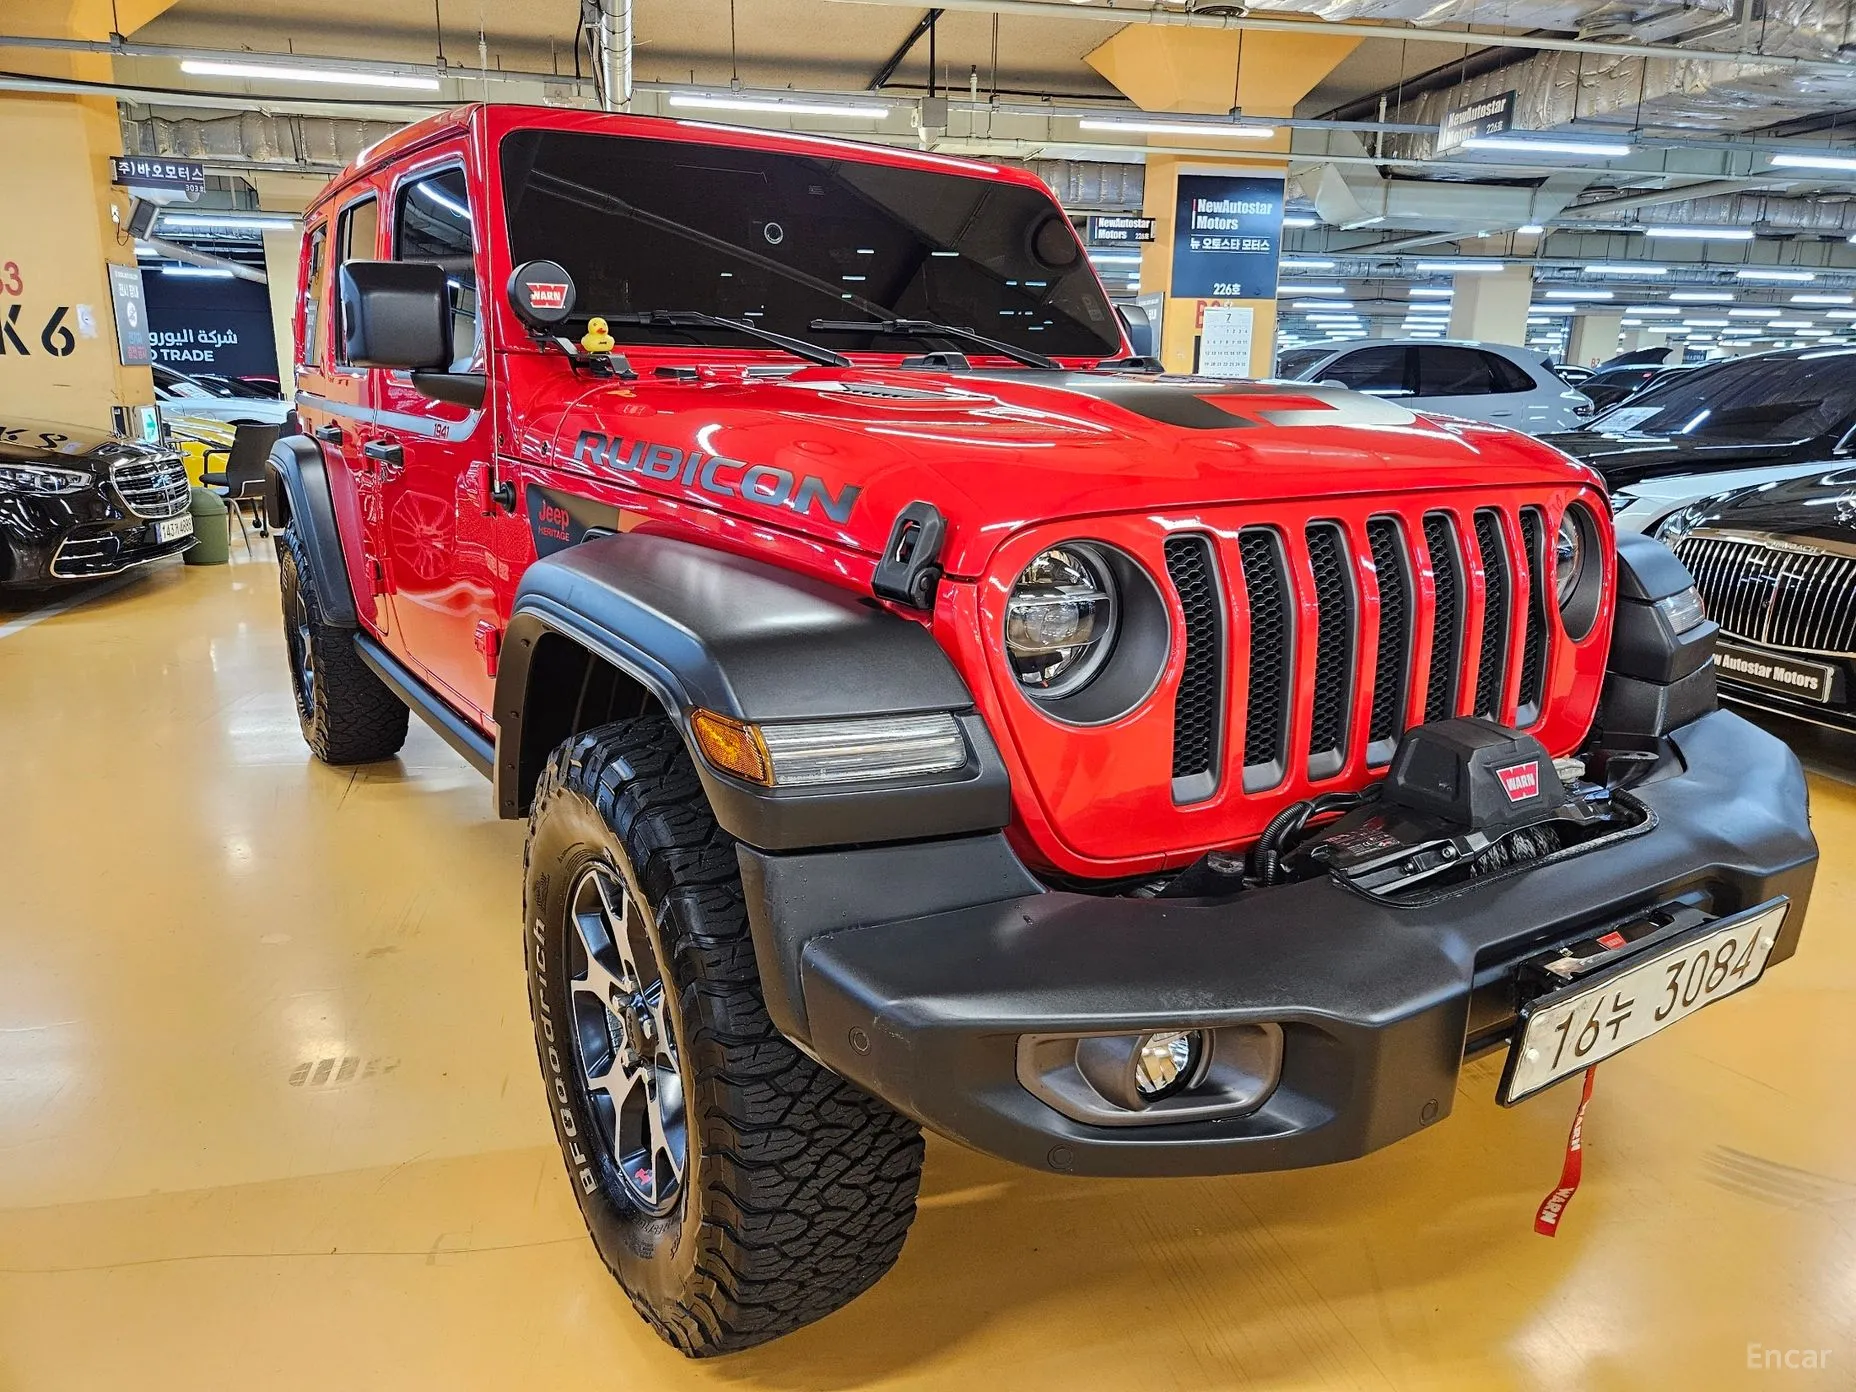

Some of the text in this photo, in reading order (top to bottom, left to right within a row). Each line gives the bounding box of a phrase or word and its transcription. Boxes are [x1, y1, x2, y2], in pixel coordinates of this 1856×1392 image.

[1448, 98, 1506, 128] NewAutostar
[1445, 126, 1477, 146] Motors
[118, 161, 204, 181] 주)바오모터스
[1198, 199, 1273, 215] NewAutostar
[1098, 217, 1150, 229] NewAutostar
[1197, 215, 1239, 230] Motors
[1098, 231, 1127, 239] Motors
[1190, 237, 1270, 251] 뉴 오토스타 모터스
[0, 261, 23, 296] 3
[1213, 283, 1241, 295] 226호
[41, 306, 75, 357] 6
[198, 329, 238, 347] شركة
[160, 349, 214, 361] TRADE
[434, 423, 449, 439] 1941
[573, 430, 864, 524] RUBICON
[538, 500, 570, 531] Jeep
[538, 525, 570, 541] HERITAGE
[1723, 653, 1772, 679] Autostar
[1773, 666, 1819, 690] Motors
[1505, 773, 1536, 792] WARN
[1551, 924, 1763, 1069] 16누 3084
[533, 916, 598, 1195] BFGoodrich
[1541, 1187, 1574, 1224] WARN
